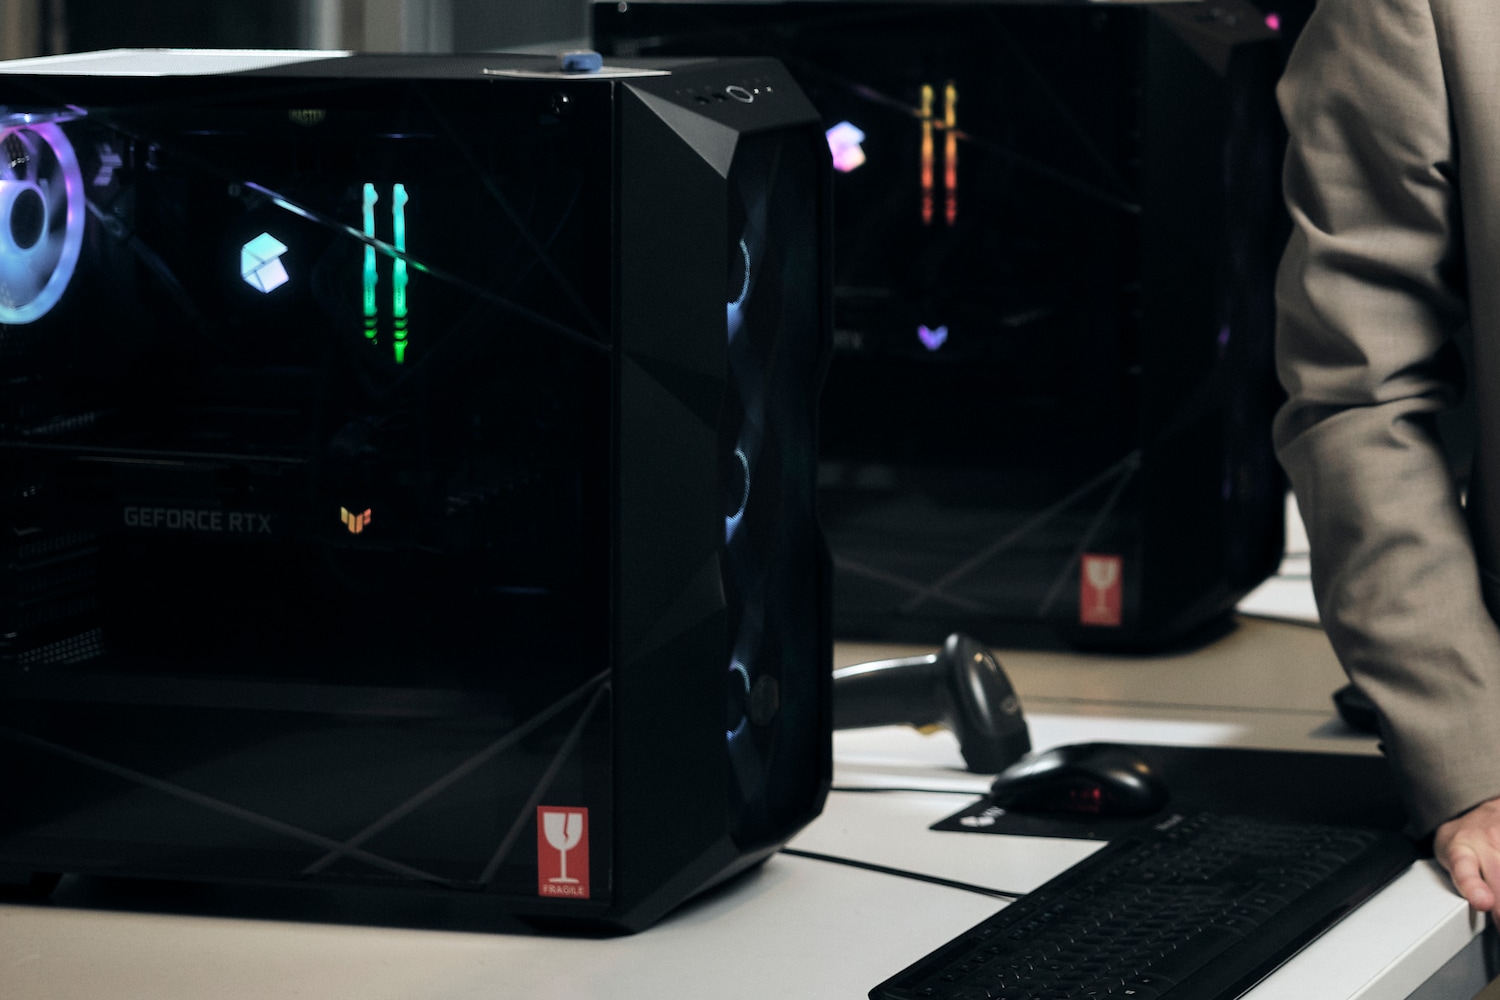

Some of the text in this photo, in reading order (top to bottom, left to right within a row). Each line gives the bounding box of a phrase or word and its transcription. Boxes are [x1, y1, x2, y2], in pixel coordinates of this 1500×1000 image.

[124, 506, 272, 535] GEFORCE RTX
[542, 883, 584, 896] FRAGILE
